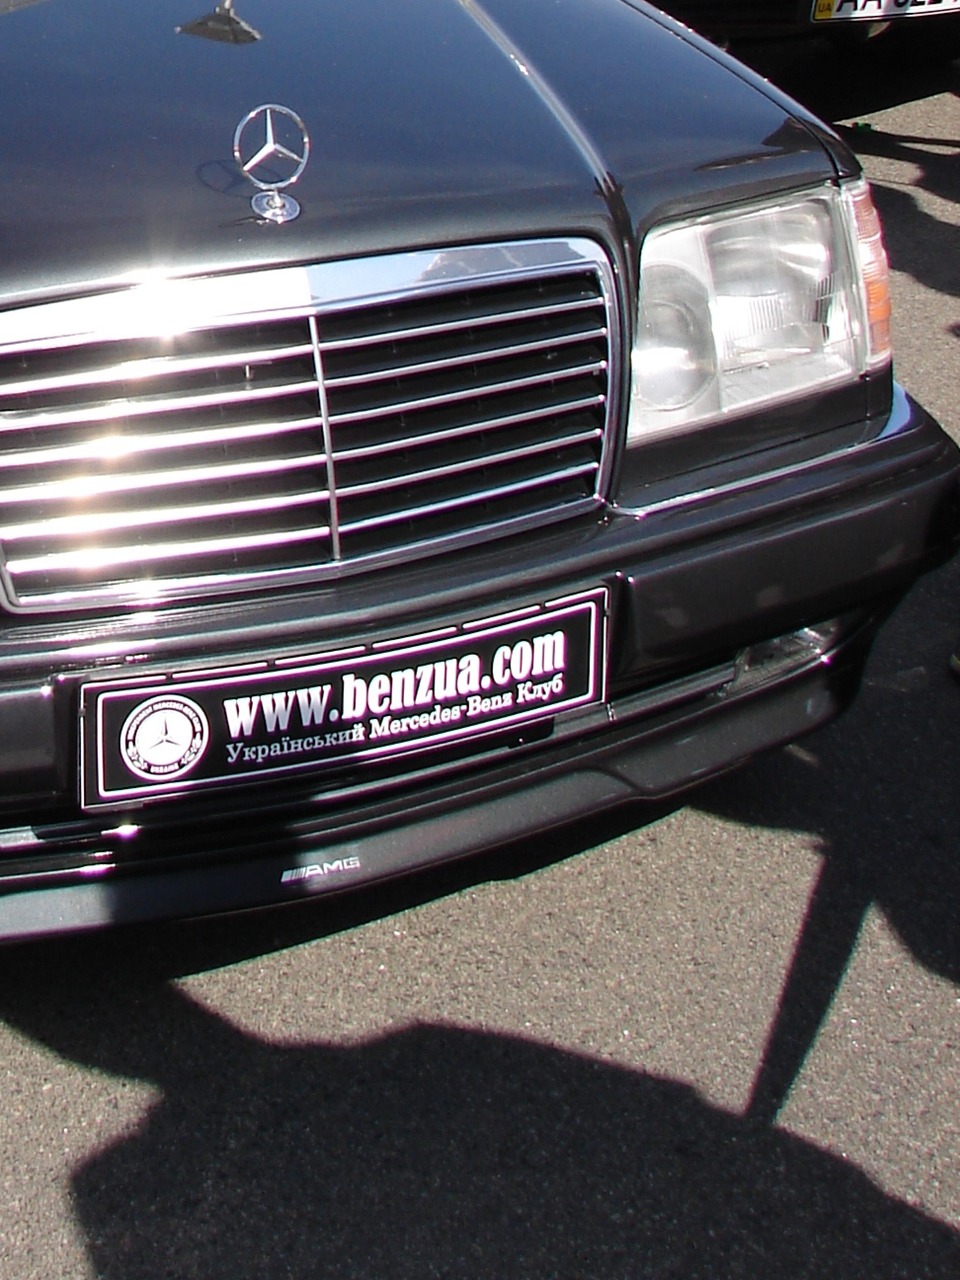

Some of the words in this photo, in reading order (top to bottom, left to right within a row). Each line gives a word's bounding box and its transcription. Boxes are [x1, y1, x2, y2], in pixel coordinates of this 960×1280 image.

[817, 3, 832, 13] UA
[223, 630, 565, 738] www.benzua.com
[226, 723, 366, 763] Український
[368, 698, 513, 739] Mercedes-Benz
[516, 673, 563, 704] Клуб
[304, 856, 360, 878] AMG
